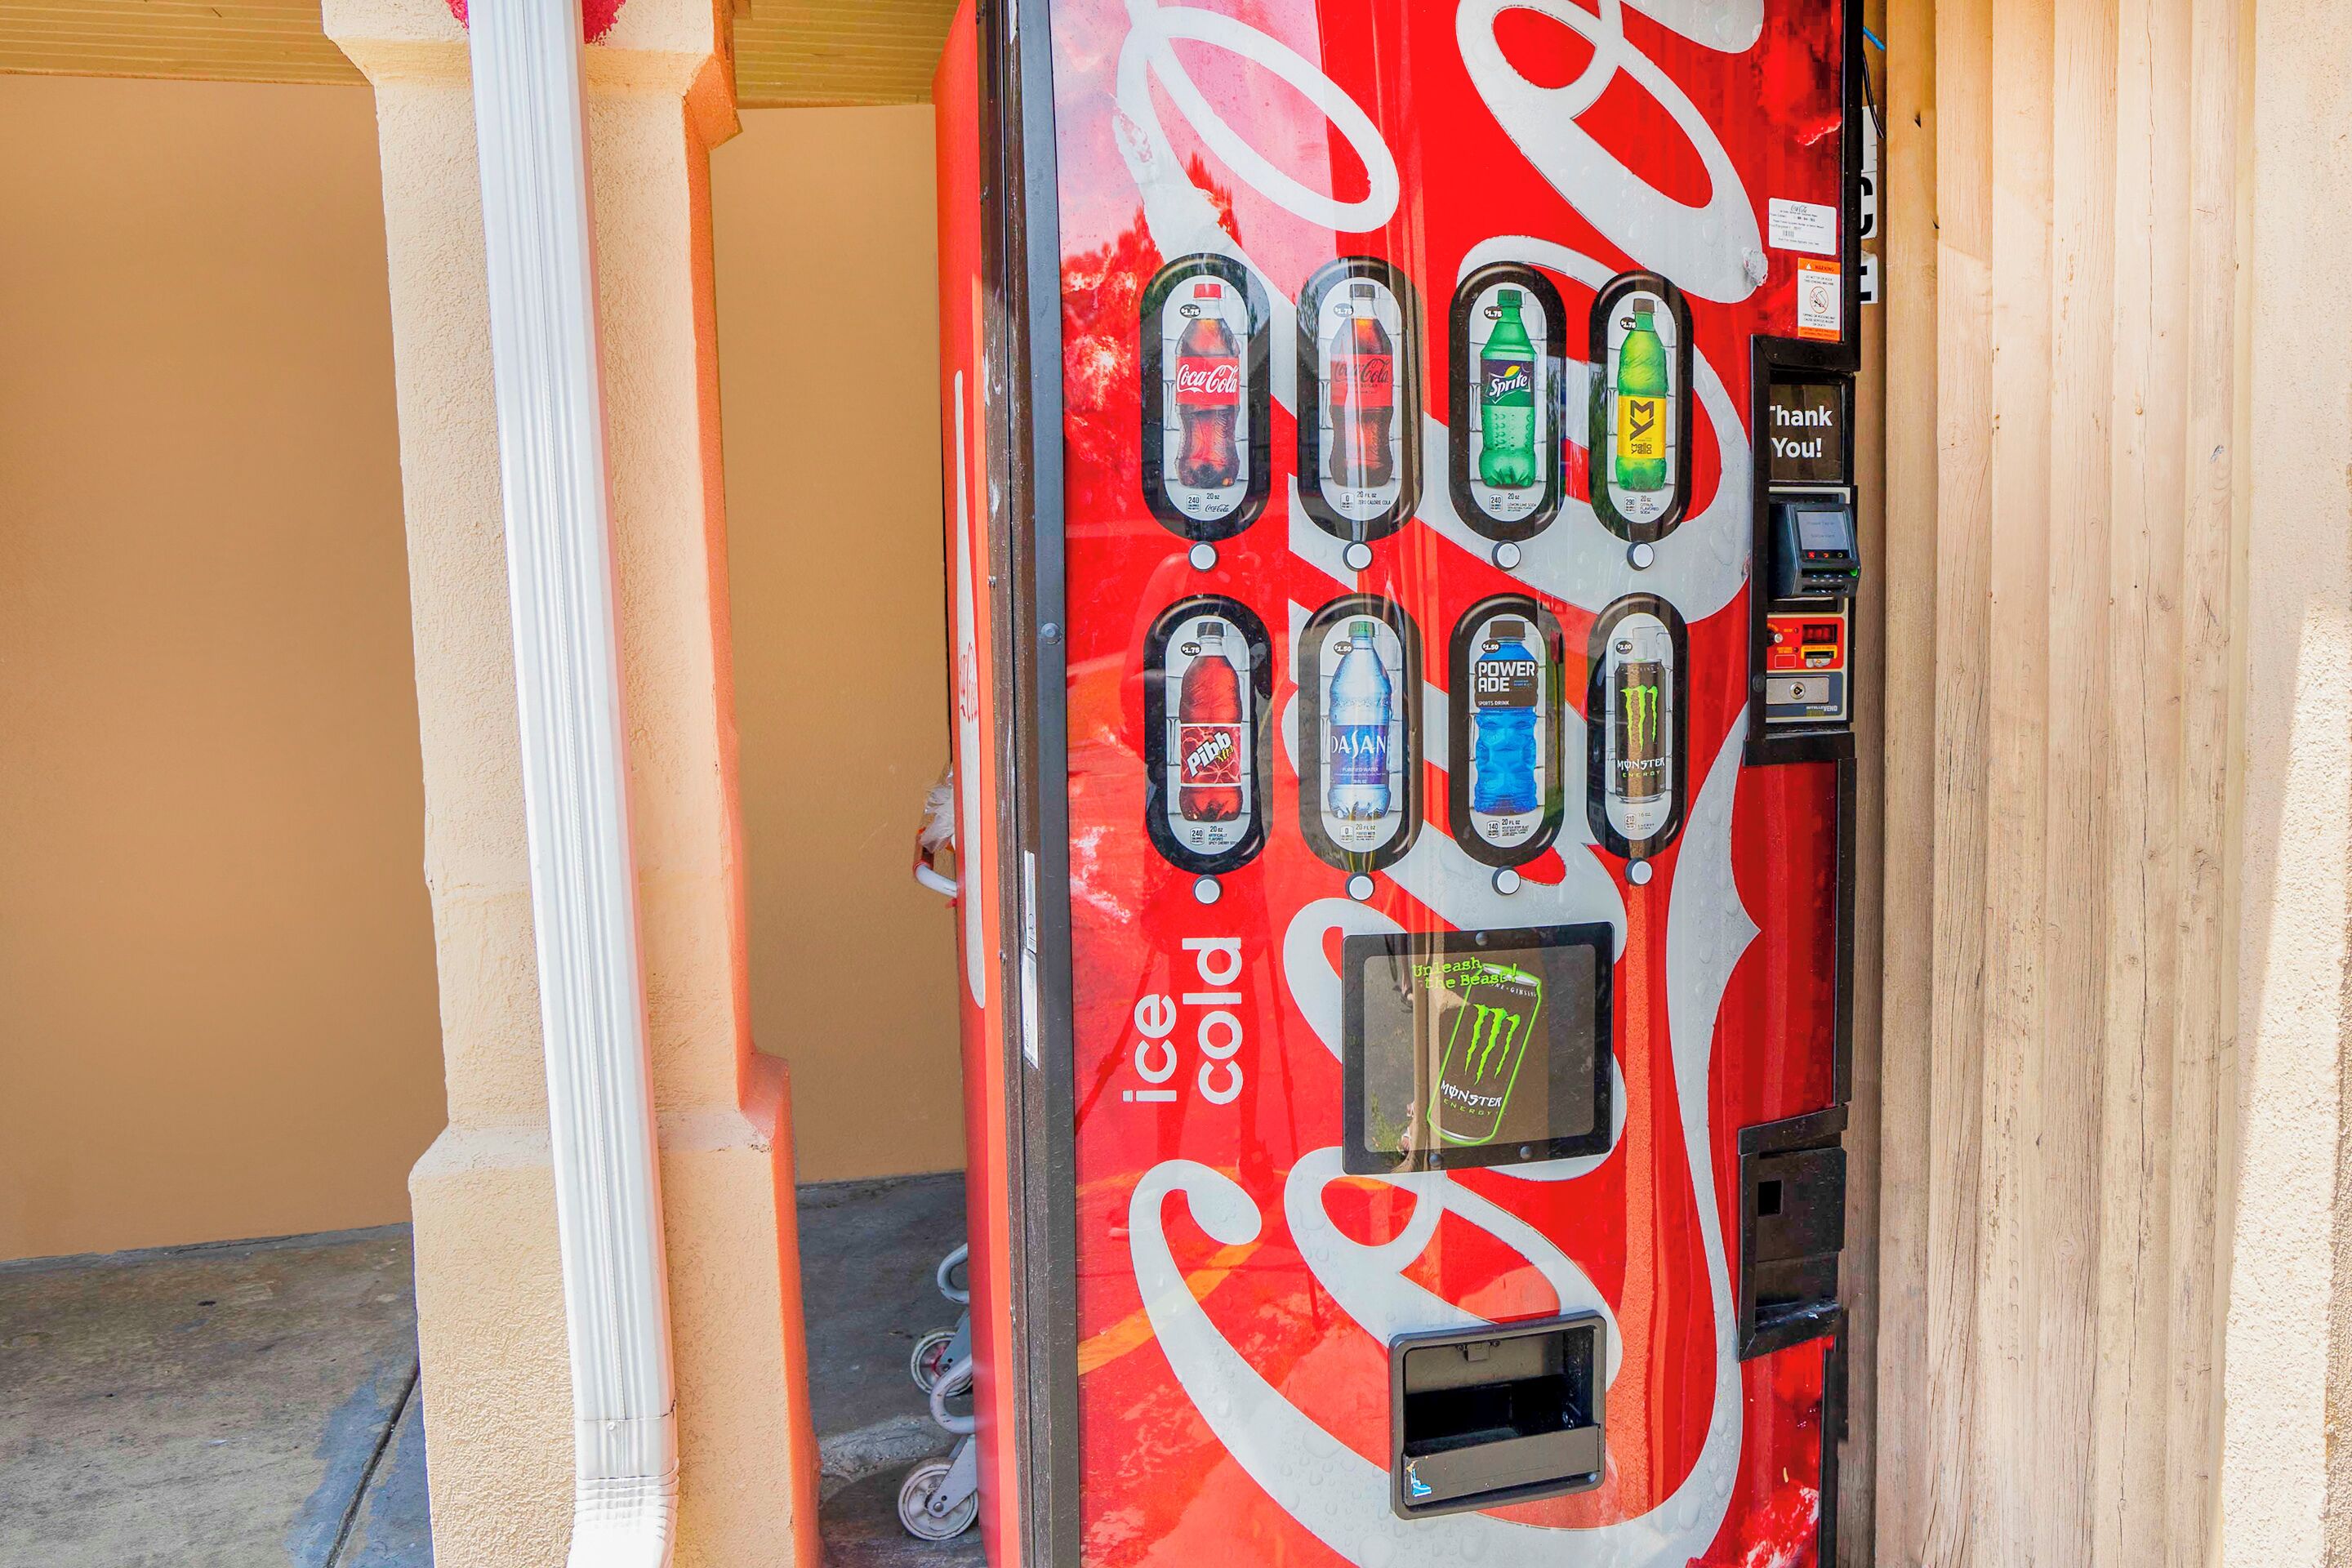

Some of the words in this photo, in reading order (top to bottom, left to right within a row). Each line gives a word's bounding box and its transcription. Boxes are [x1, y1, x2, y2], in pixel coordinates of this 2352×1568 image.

[1177, 364, 1238, 393] Coca-Cola
[1489, 372, 1527, 397] Sprite
[1771, 438, 1822, 457] You!
[1478, 661, 1535, 677] POWER
[1478, 677, 1510, 693] ADE
[1187, 732, 1232, 778] Pibb
[1617, 757, 1665, 771] MONSTER
[1116, 0, 1768, 1568] Coca-Co
[1411, 956, 1483, 977] Unleash
[1425, 977, 1455, 989] the
[1460, 963, 1517, 986] Beast!
[1182, 938, 1244, 1104] cold
[1122, 994, 1177, 1102] ice
[1441, 1080, 1503, 1107] MONSTER
[1443, 1098, 1492, 1116] ENERGY
